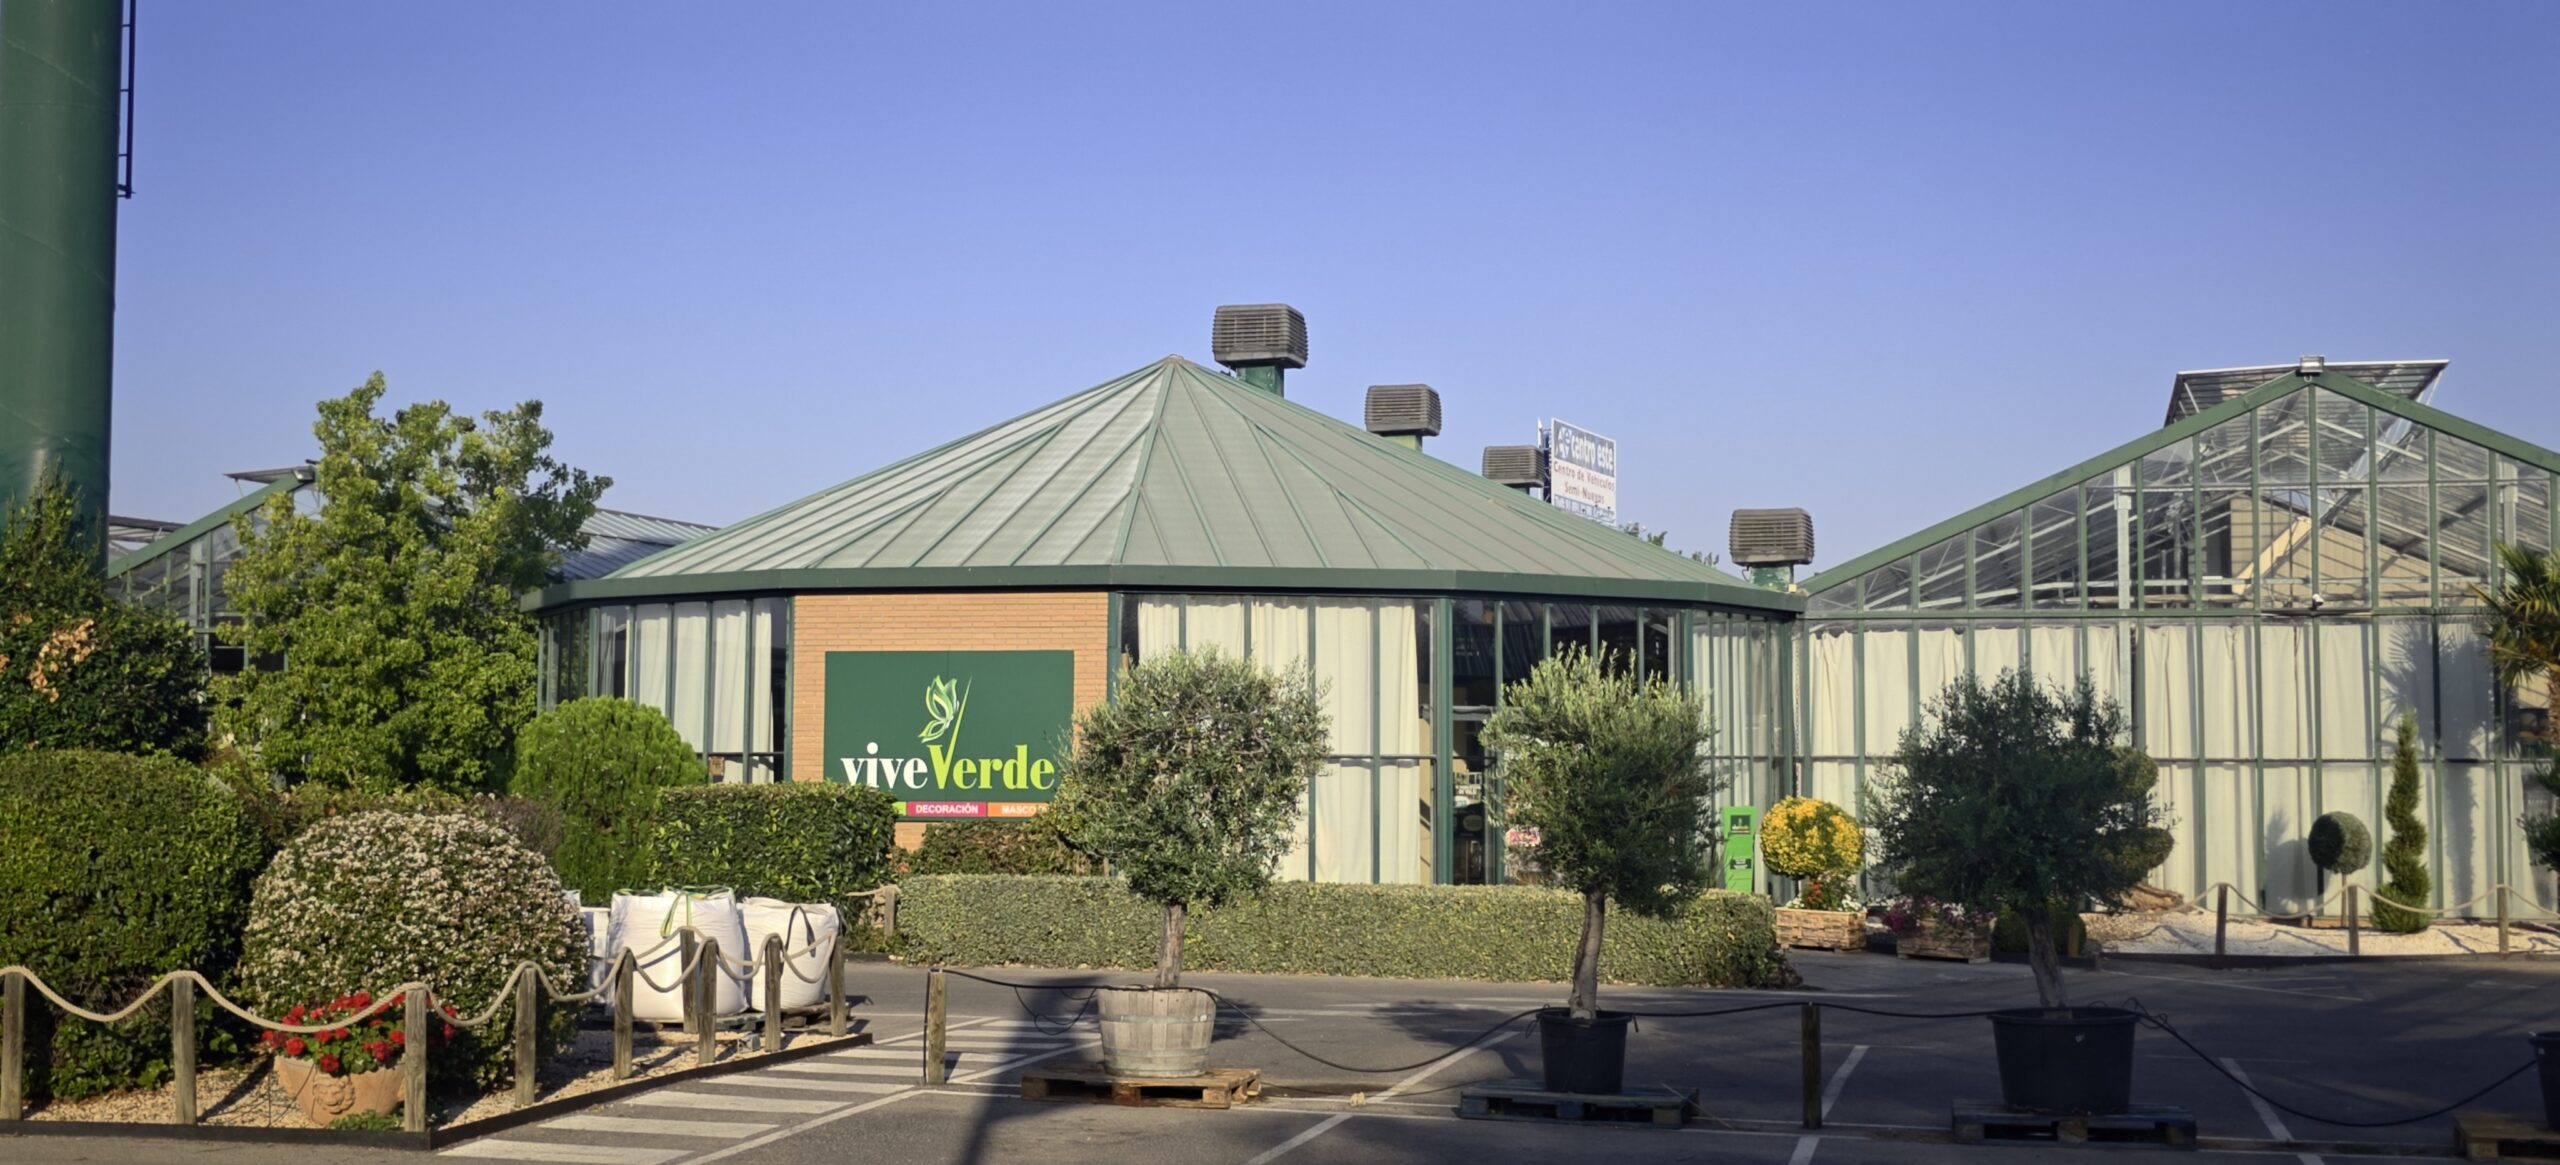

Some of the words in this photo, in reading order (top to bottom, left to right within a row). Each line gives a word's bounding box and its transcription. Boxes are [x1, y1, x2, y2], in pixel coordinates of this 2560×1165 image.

[1554, 460, 1576, 478] Centro
[1577, 469, 1585, 481] de
[915, 803, 979, 814] DECORACIÓN
[1001, 804, 1048, 815] MASCO
